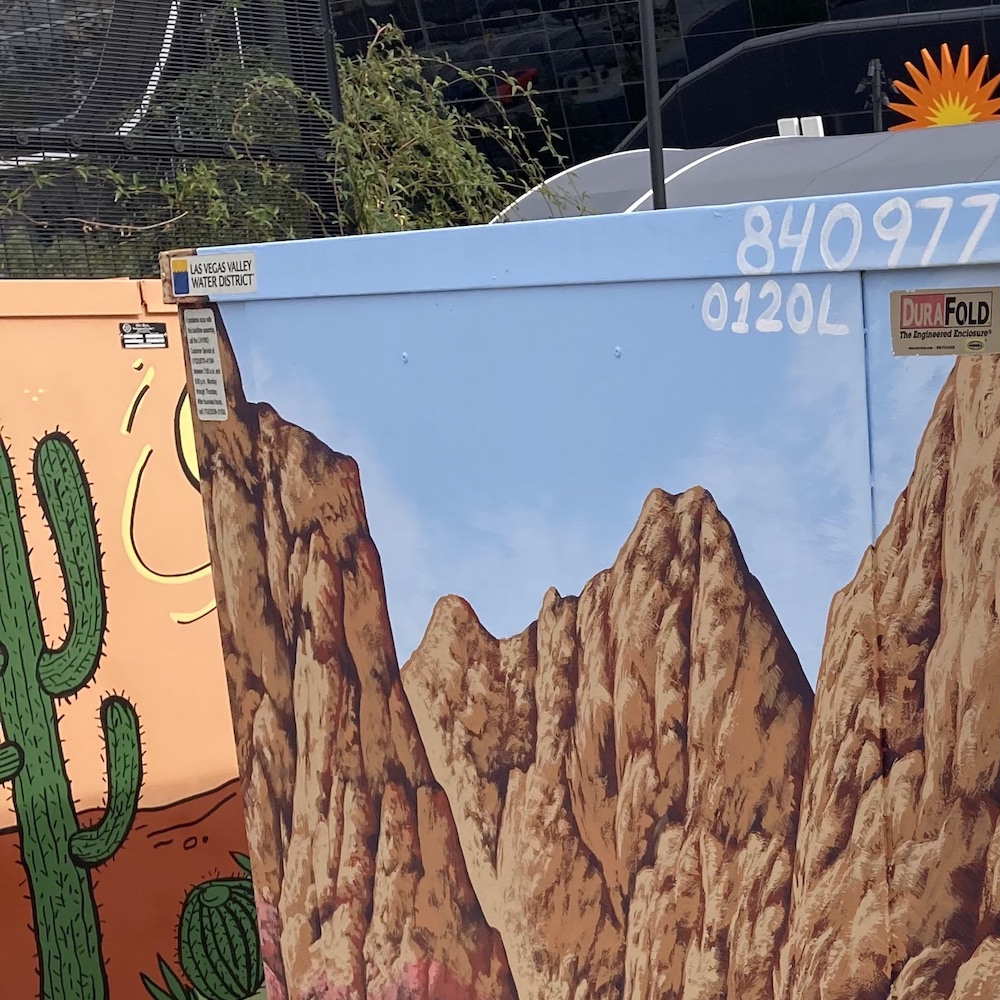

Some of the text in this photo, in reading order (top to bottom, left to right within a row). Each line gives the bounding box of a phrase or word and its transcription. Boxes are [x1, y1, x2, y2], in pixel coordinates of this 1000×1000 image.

[737, 194, 1000, 275] 840977
[190, 259, 252, 275] LAS VEGAS VALLEY
[191, 273, 253, 288] WATER DISTRICT
[702, 280, 849, 335] 0120L
[900, 330, 912, 339] The
[913, 329, 953, 341] Engineered
